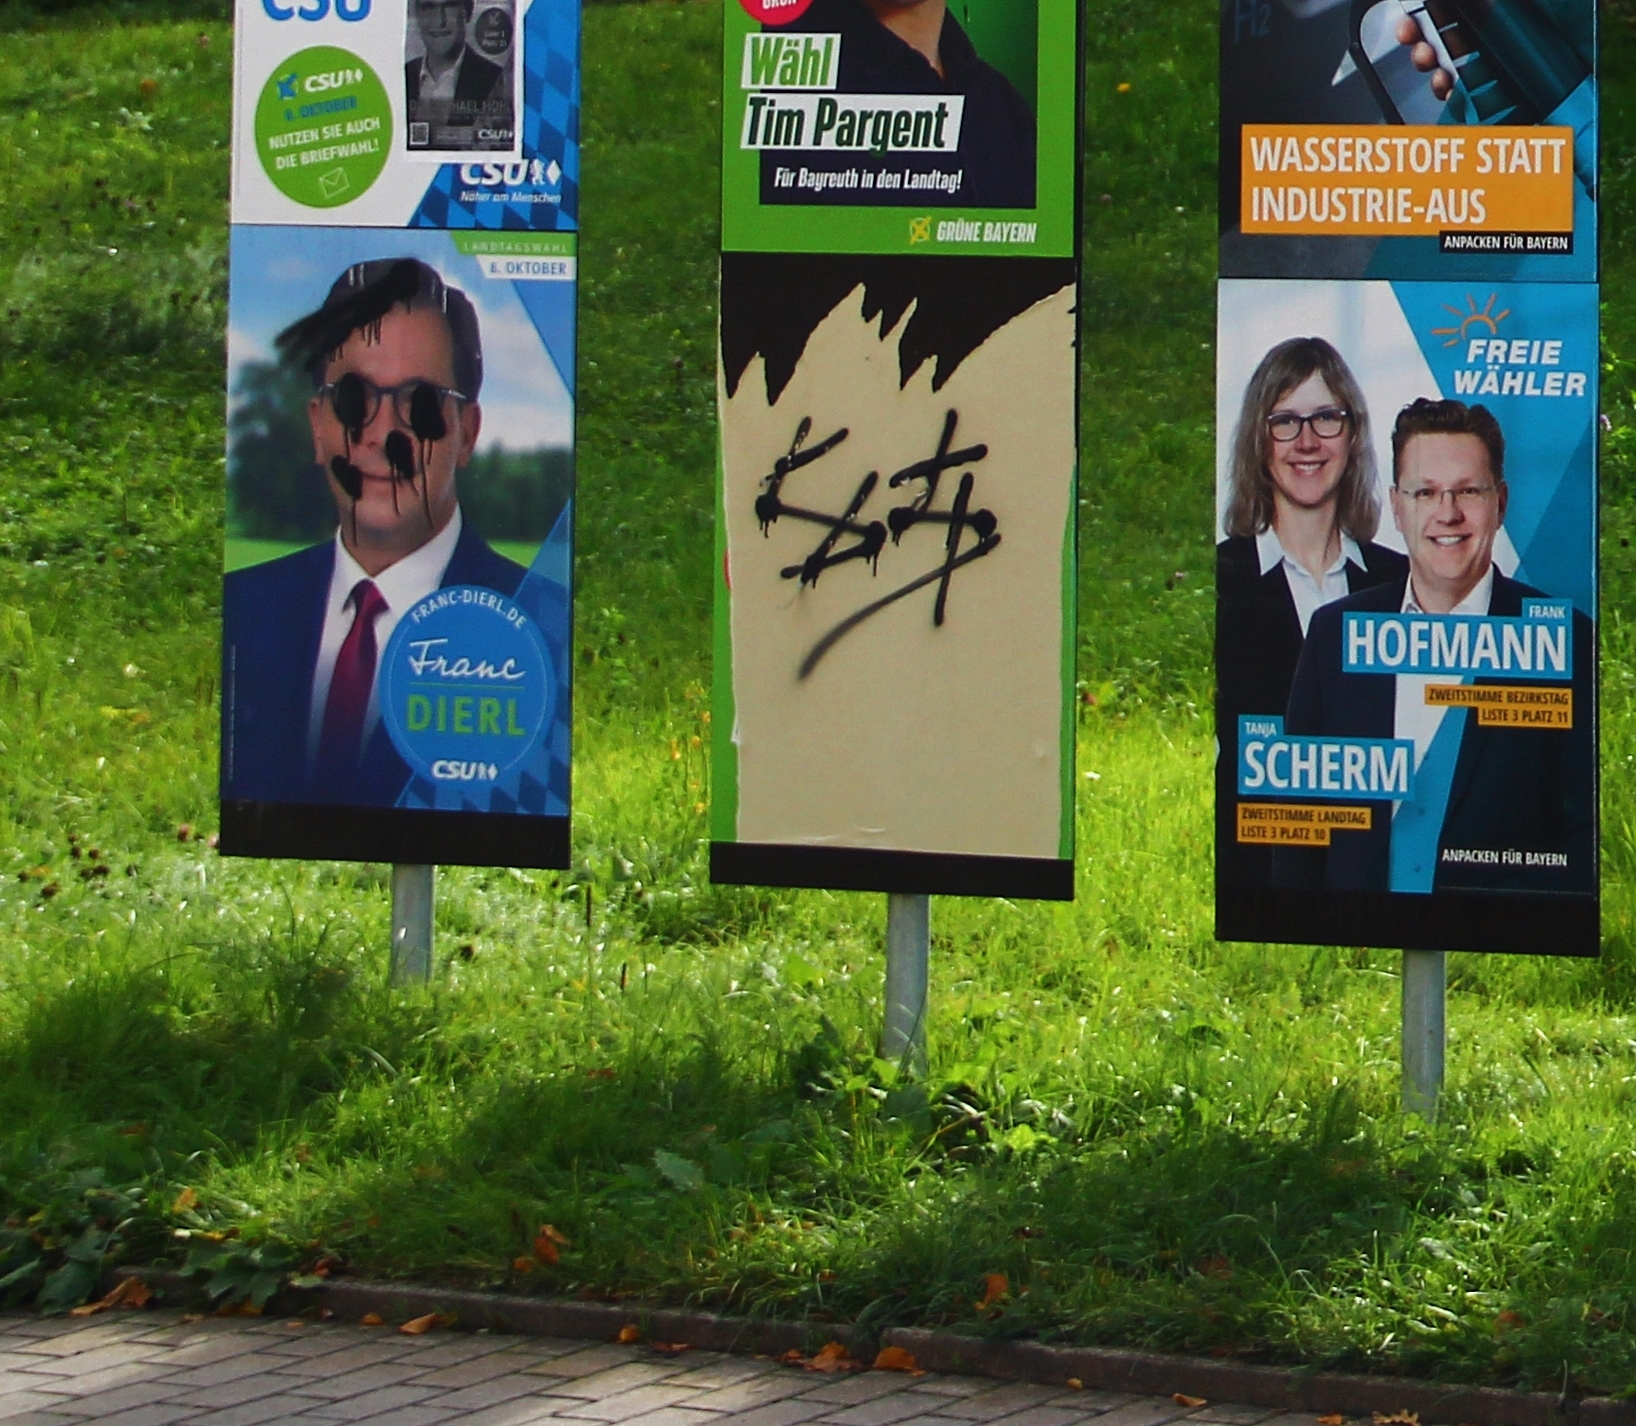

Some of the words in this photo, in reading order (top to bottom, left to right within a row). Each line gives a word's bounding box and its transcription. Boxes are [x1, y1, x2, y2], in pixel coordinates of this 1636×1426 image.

[305, 71, 343, 92] CSU
[269, 127, 317, 149] NUTZEN
[322, 123, 342, 141] SIE
[347, 117, 380, 136] AUCH
[747, 97, 805, 147] Tim
[814, 98, 948, 158] Pargent
[276, 152, 298, 169] DIE
[301, 138, 379, 165] BRIEFWAHL!
[1251, 136, 1465, 174] WASSERSTOFF
[1476, 137, 1565, 174] STATT
[460, 159, 529, 185] CSU
[774, 167, 796, 187] Für
[799, 168, 858, 191] Bayreuth
[861, 169, 874, 188] in
[877, 170, 900, 189] den
[904, 170, 962, 193] Landtag!
[460, 189, 492, 203] Näher
[492, 192, 509, 202] am
[511, 190, 562, 203] Menschen
[1252, 187, 1485, 225] INDUSTRIE-AUS
[937, 218, 981, 242] GRÜNE
[985, 222, 1037, 243] BAYERN
[1529, 606, 1564, 620] FRANK
[1348, 618, 1567, 672] HOFMANN
[1429, 688, 1503, 704] ZWEITSTIMME
[1506, 691, 1568, 705] BEZIRKSTAG
[1245, 721, 1277, 737] TANJA
[1244, 742, 1408, 793] SCHERM
[1242, 808, 1314, 823] ZWEITSTIMME
[1316, 809, 1366, 825] LANDTAG
